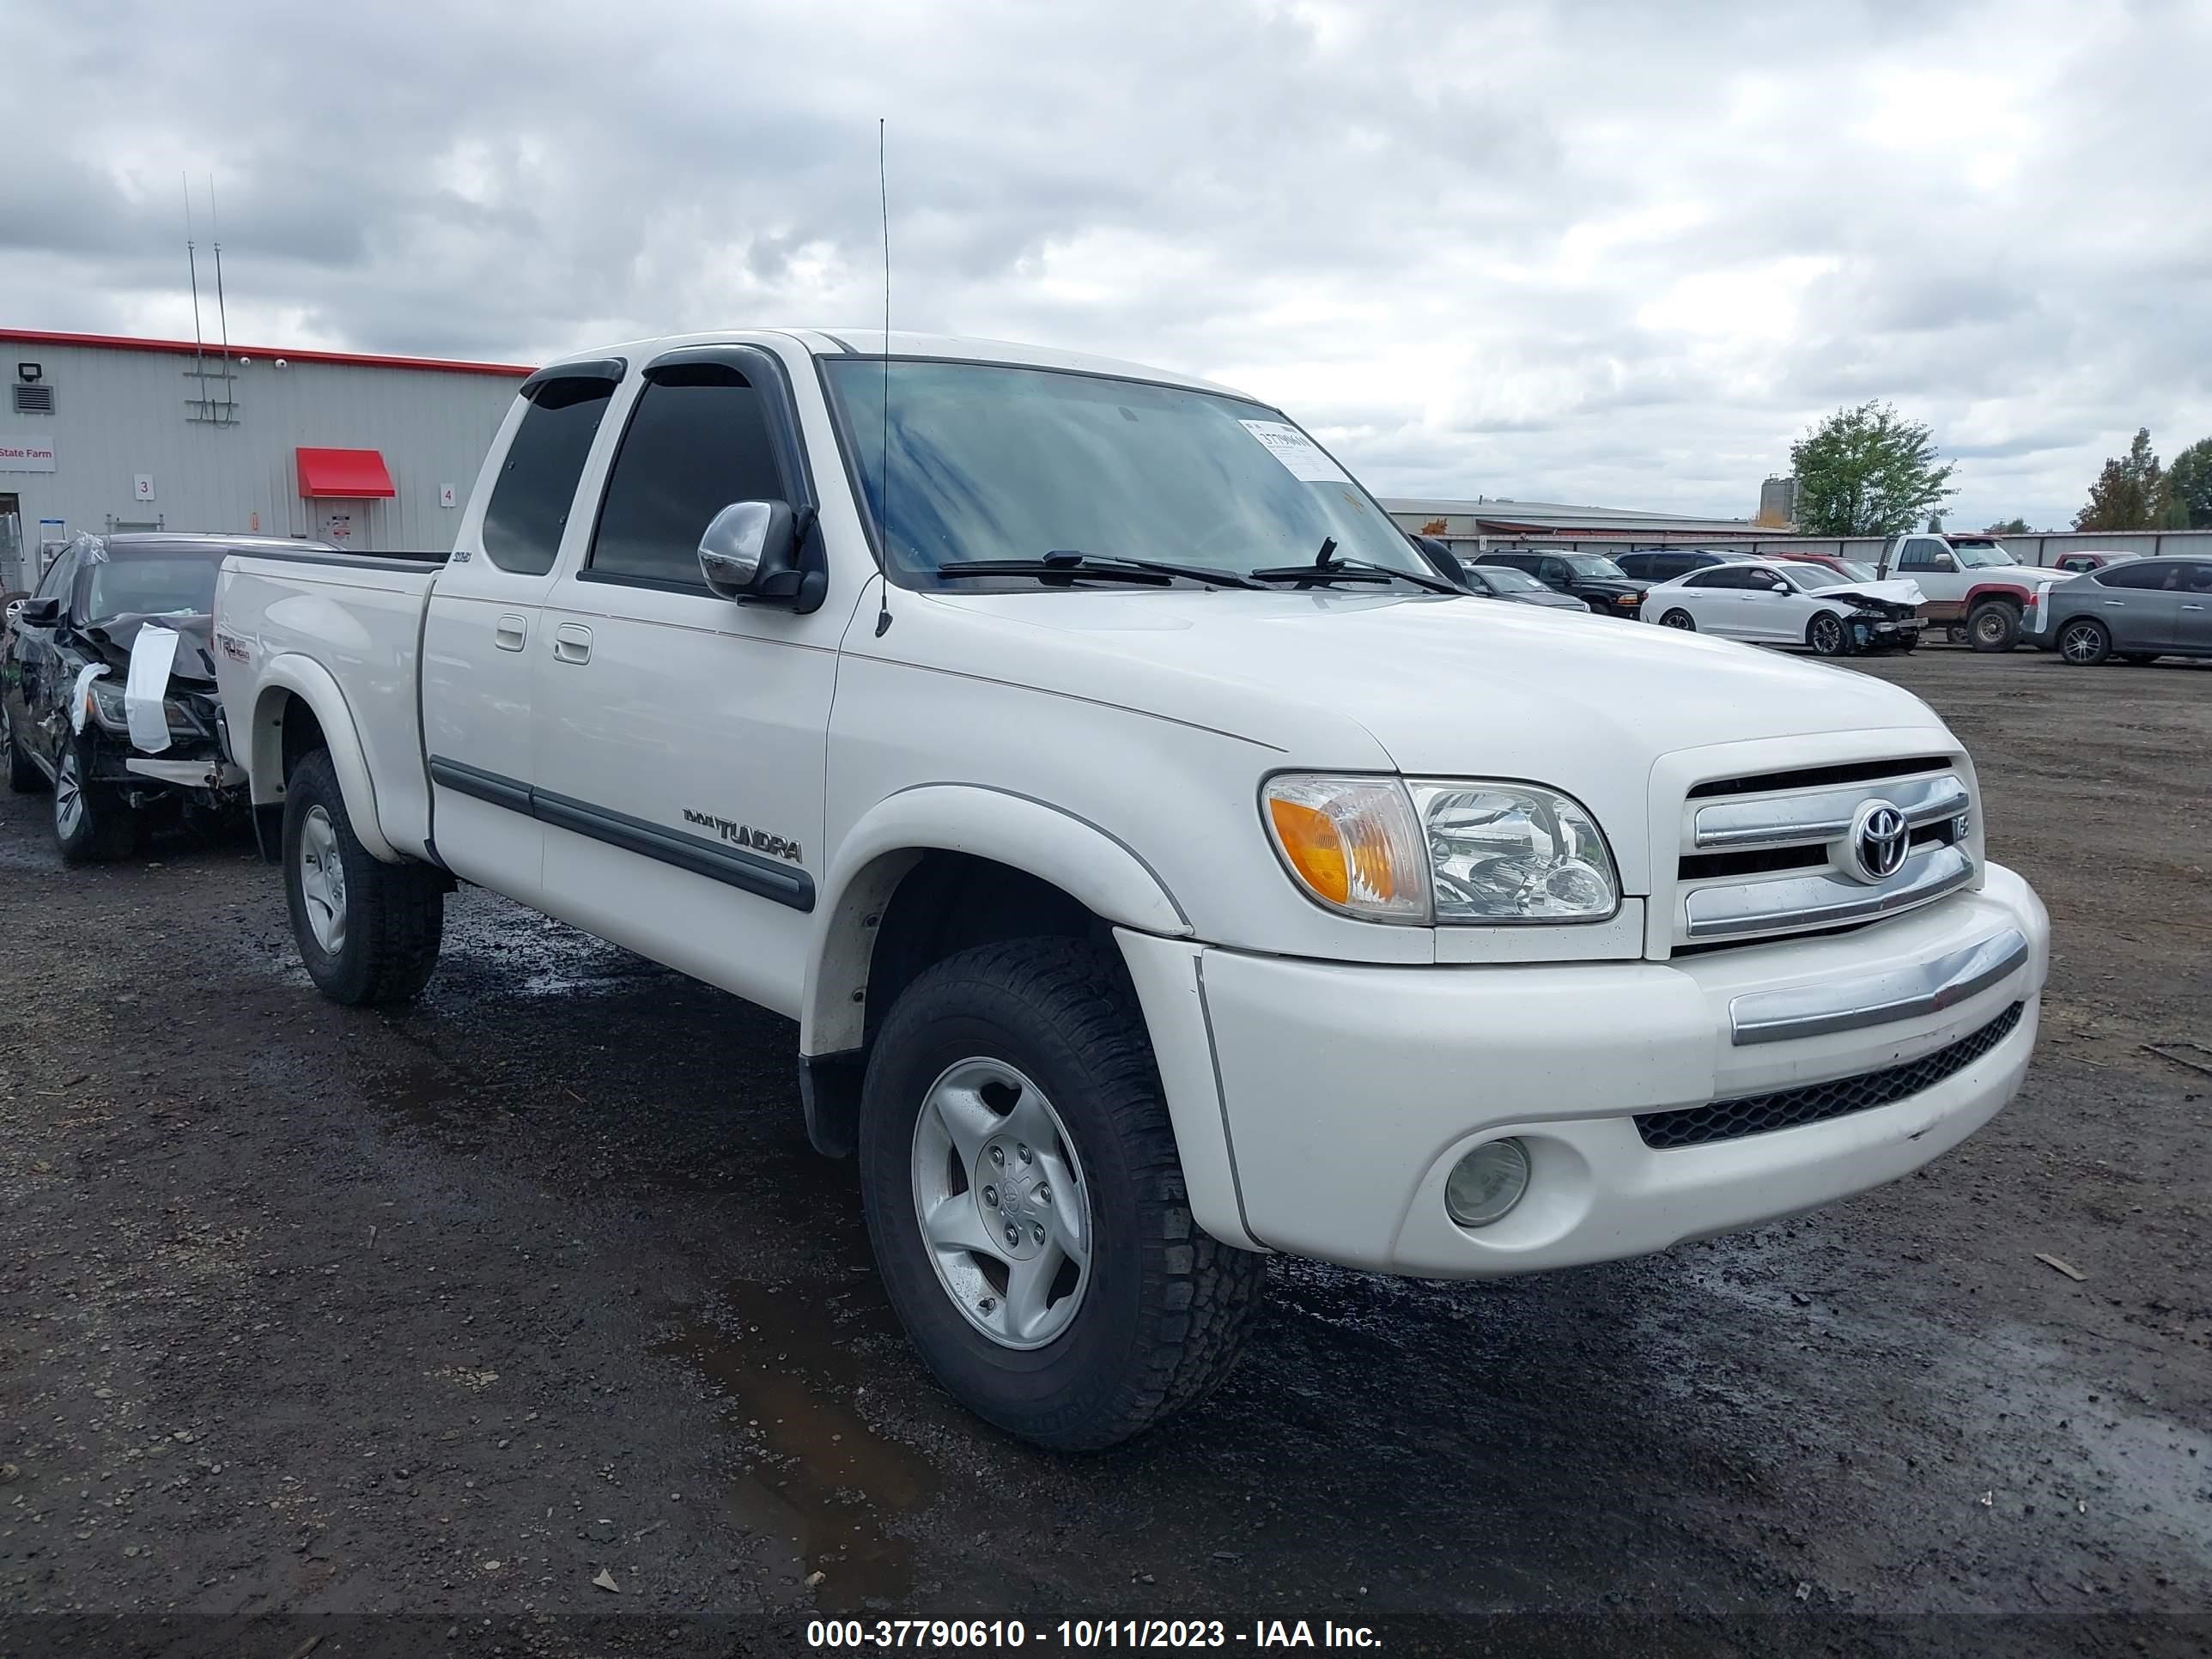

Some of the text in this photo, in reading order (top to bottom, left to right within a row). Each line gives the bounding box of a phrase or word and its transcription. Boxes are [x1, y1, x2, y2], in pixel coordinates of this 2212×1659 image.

[27, 449, 52, 459] Farm
[141, 481, 149, 493] 3
[445, 489, 452, 501] 4
[216, 633, 236, 658] TRD
[717, 817, 803, 864] TUNDRA
